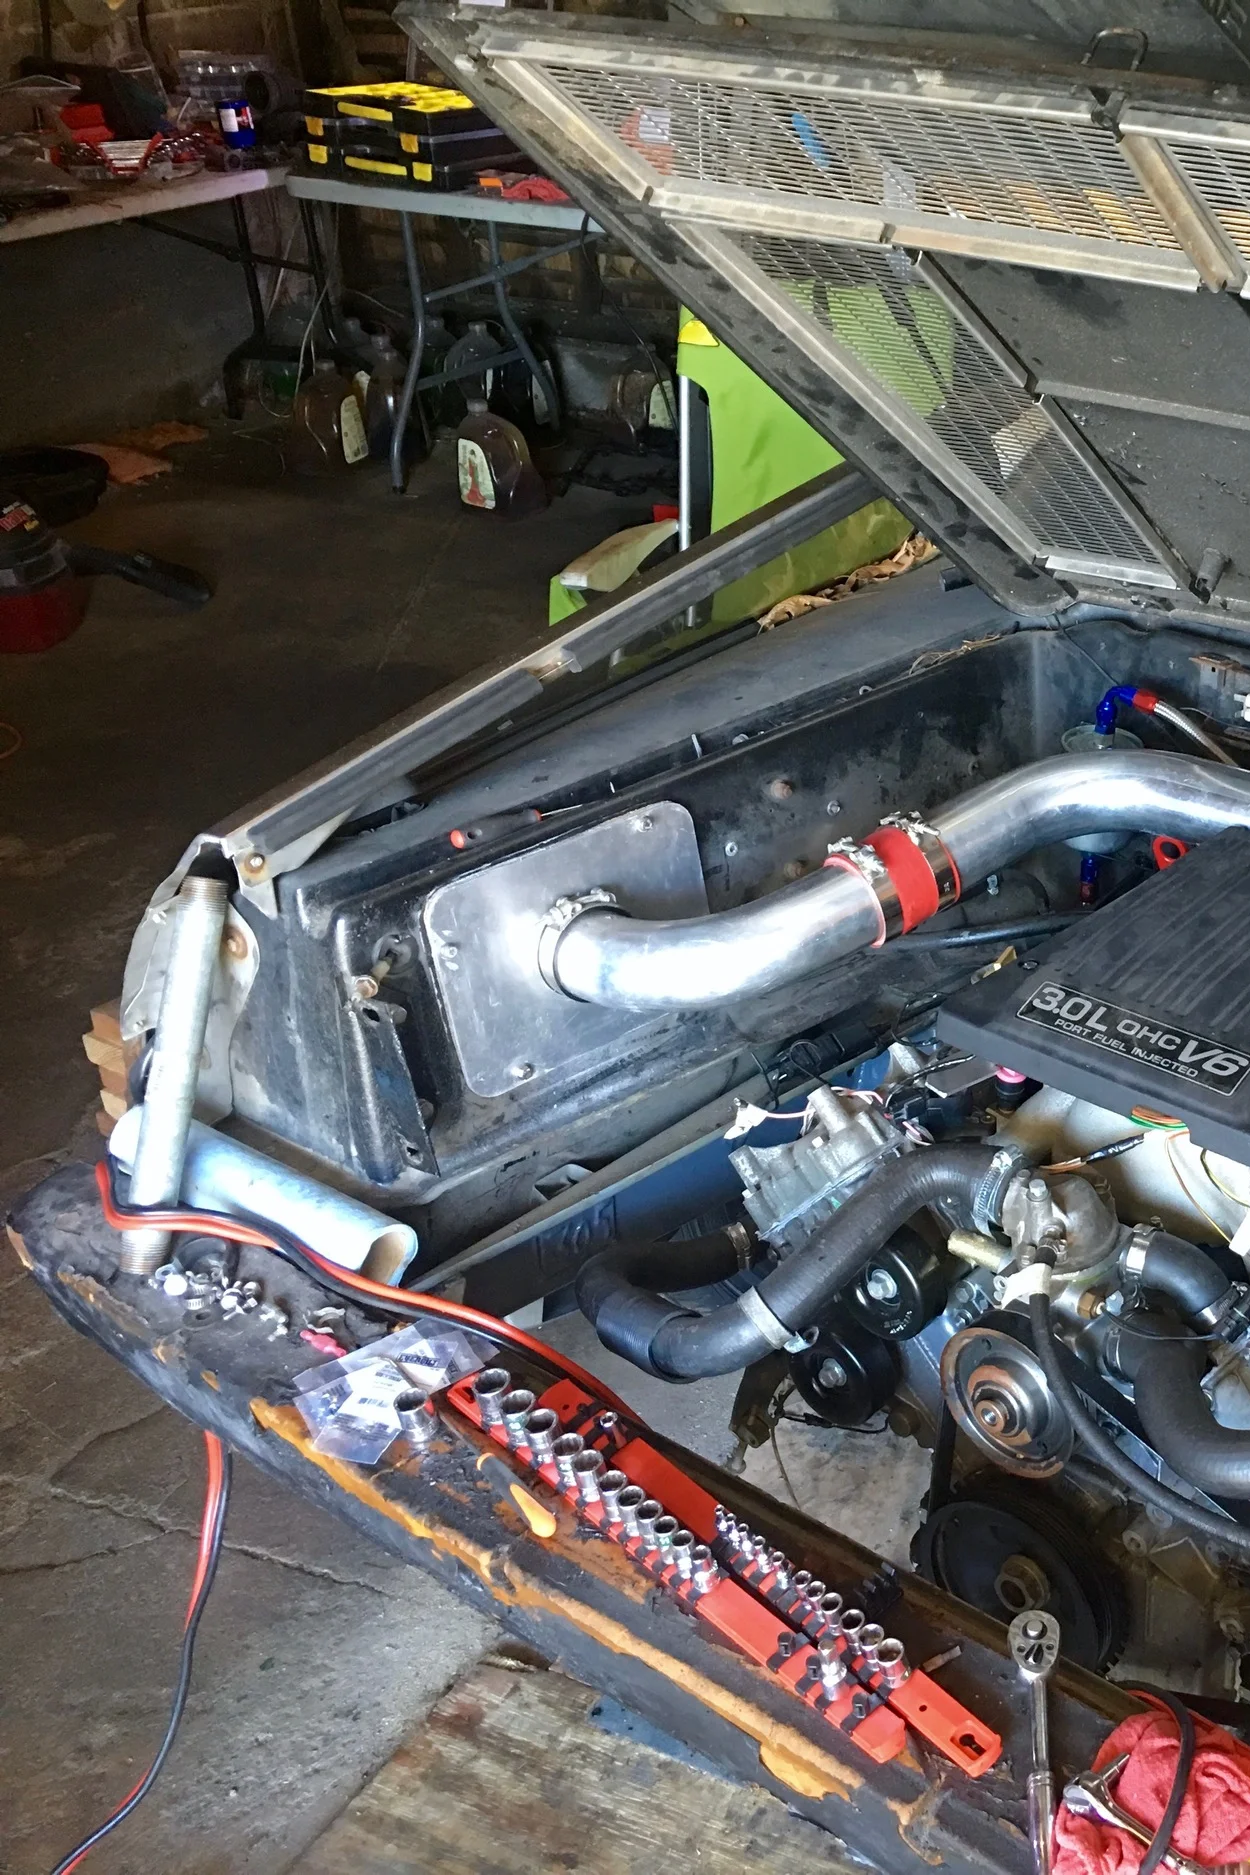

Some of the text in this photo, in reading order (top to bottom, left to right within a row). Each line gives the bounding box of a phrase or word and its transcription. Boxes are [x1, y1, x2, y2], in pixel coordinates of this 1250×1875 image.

[1054, 1018, 1199, 1077] PORT FUEL INJECTED
[1116, 1019, 1182, 1050] OHC
[1178, 1039, 1250, 1077] V6
